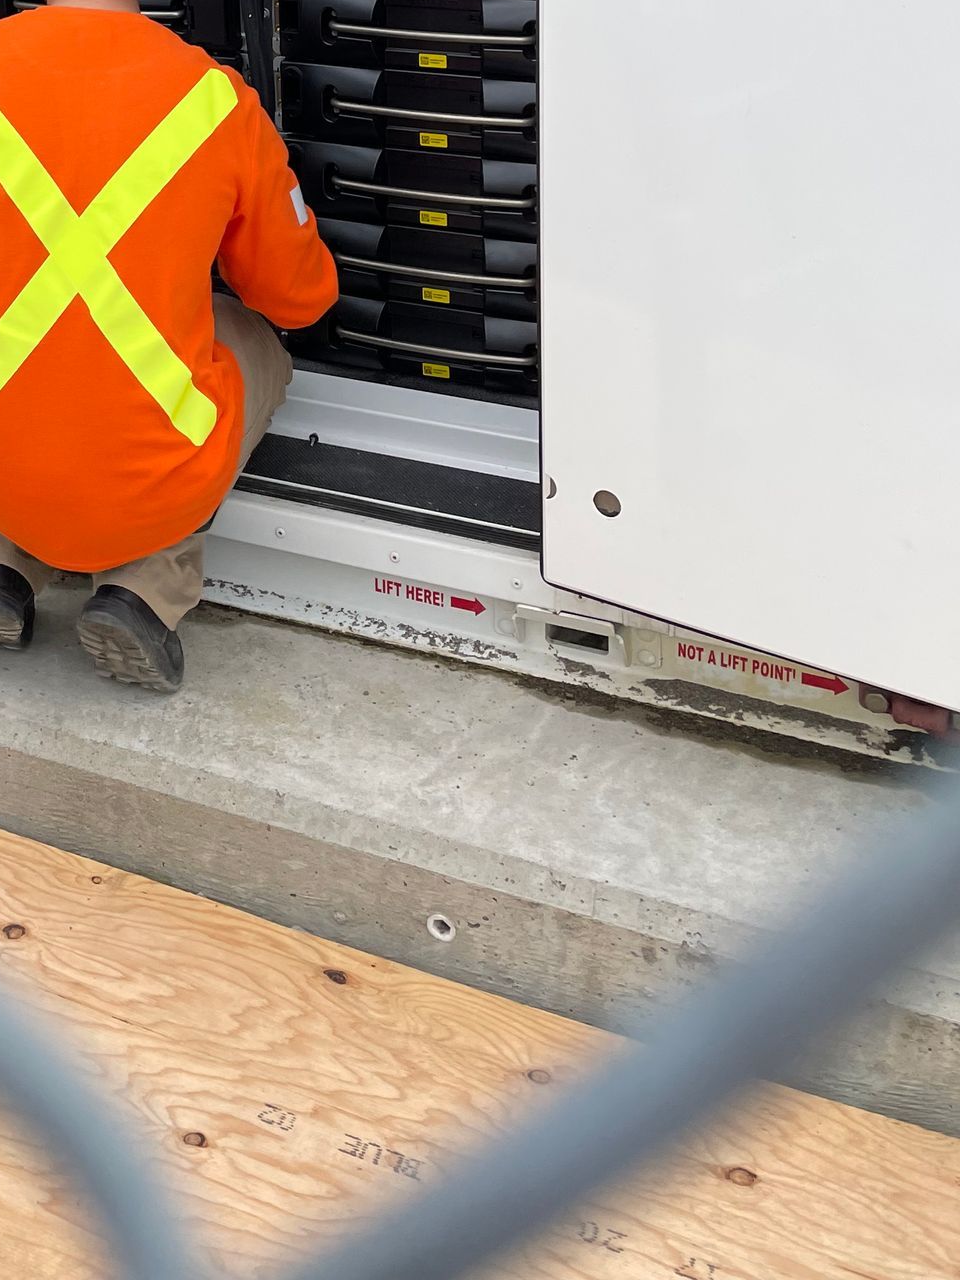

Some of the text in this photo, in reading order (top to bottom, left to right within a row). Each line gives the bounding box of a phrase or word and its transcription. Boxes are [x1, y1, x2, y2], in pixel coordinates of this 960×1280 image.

[375, 578, 444, 607] LIFT HERE!
[678, 642, 704, 661] NOT
[708, 650, 716, 665] A
[720, 652, 748, 672] LIFT
[257, 1103, 424, 1181] BLUE 02
